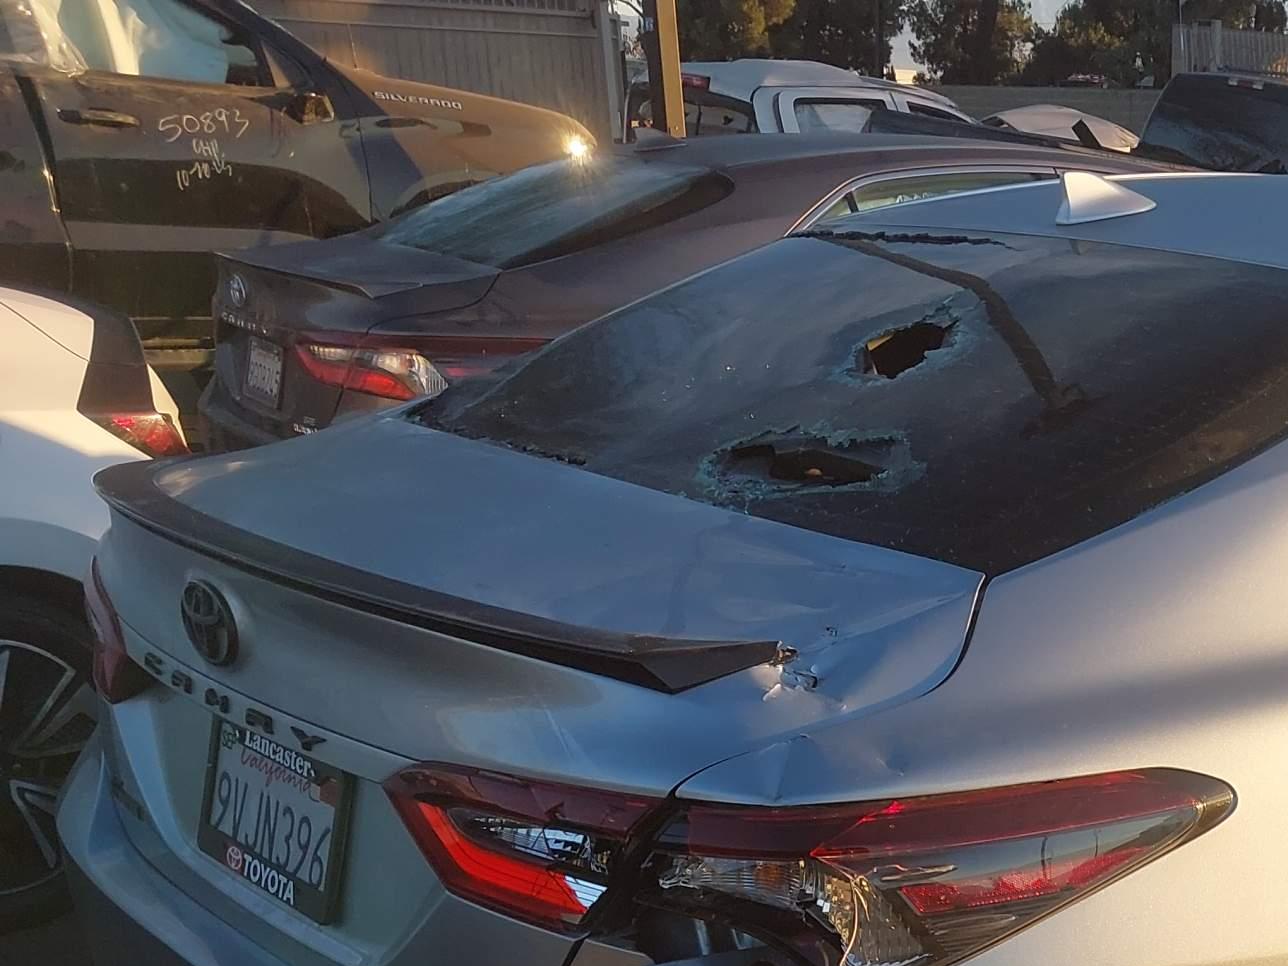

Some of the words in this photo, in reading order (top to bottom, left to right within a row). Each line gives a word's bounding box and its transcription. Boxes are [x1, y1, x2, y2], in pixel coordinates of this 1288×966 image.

[158, 108, 249, 143] 50893
[373, 91, 463, 110] SILVERADO
[144, 652, 327, 751] CAMRY
[244, 729, 313, 777] Lancaster
[207, 770, 332, 888] 9VJN396
[243, 854, 295, 906] TOYOTA
